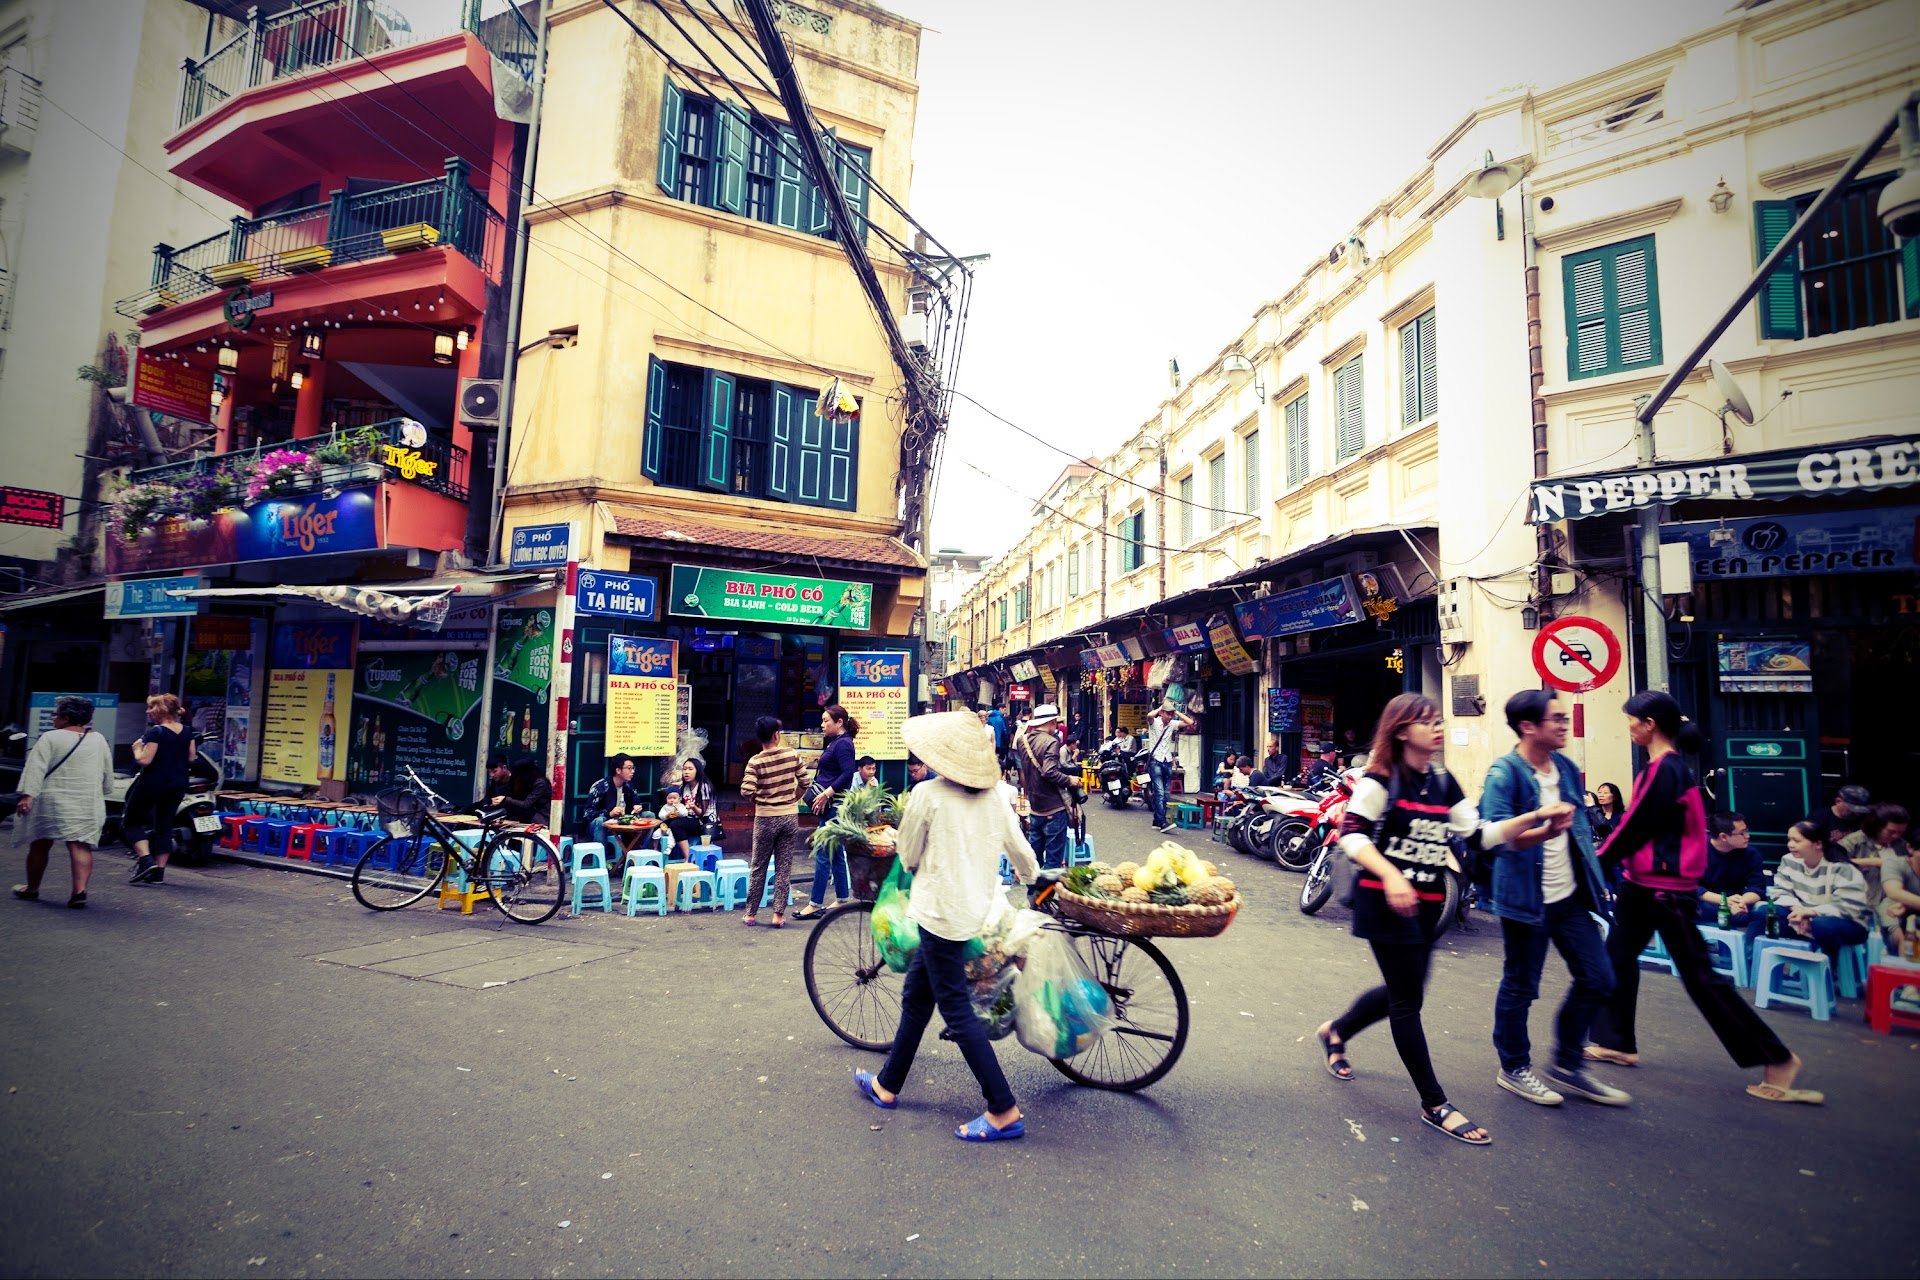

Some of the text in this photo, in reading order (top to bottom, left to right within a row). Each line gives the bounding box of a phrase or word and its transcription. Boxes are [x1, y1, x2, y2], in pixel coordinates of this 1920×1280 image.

[383, 444, 437, 480] Tiger
[1532, 464, 1754, 522] N PEPPER
[279, 502, 338, 552] Tiger
[532, 530, 552, 542] PHỐ
[1761, 550, 1895, 573] PEPPER
[604, 580, 630, 591] PHỐ
[726, 581, 756, 596] BIA
[761, 583, 797, 599] PHỐ
[587, 592, 646, 614] TẠ HIỆN
[724, 598, 740, 608] BIA
[742, 600, 766, 610] LẠNH
[775, 603, 798, 613] COLD
[800, 605, 822, 614] BEER
[1363, 596, 1398, 620] Tiger
[1175, 629, 1200, 641] BIA 23
[294, 628, 338, 665] Tiger
[530, 644, 550, 656] OPEN
[460, 659, 478, 669] OPEN
[530, 654, 549, 666] FOR
[624, 646, 670, 673] Tiger
[1385, 656, 1403, 674] Tig
[370, 669, 401, 681] TUBORG
[460, 668, 476, 679] FOR
[529, 666, 549, 680] FUN
[852, 659, 900, 683] Tiger
[458, 679, 476, 691] FUN
[635, 680, 657, 689] PHỐ
[866, 688, 885, 698] PHỐ
